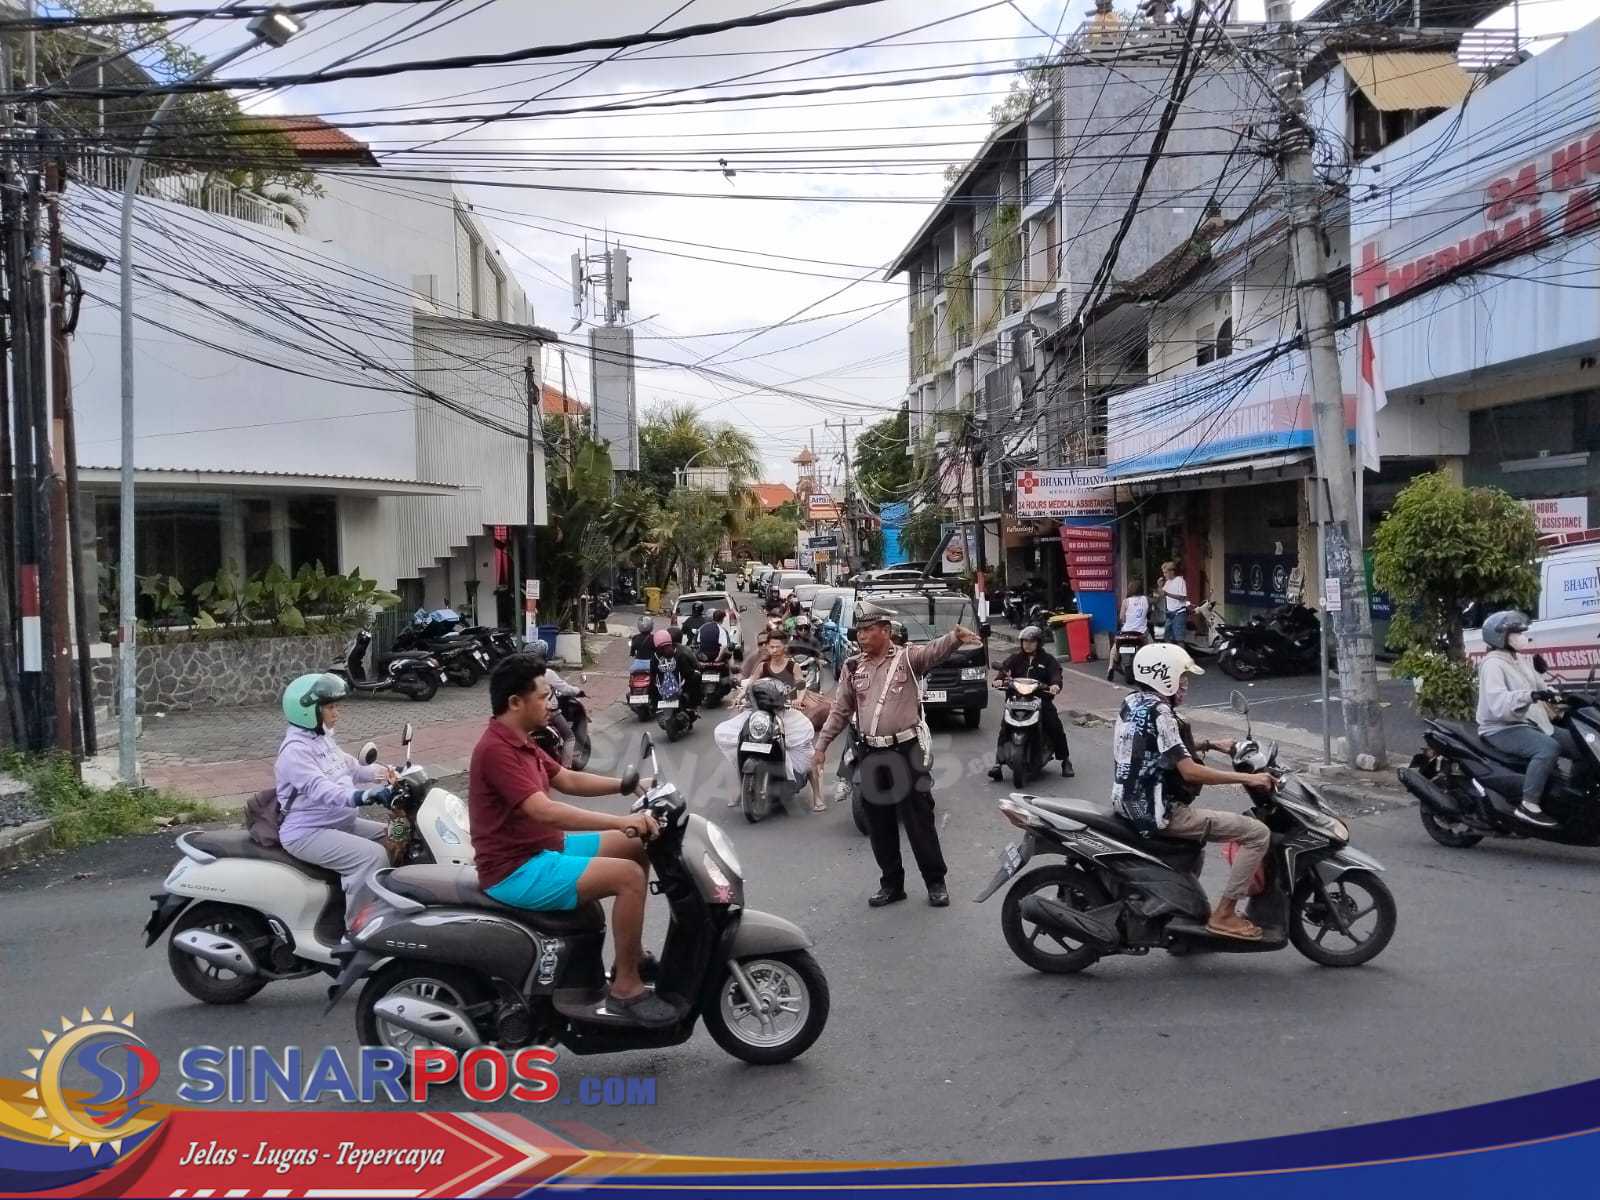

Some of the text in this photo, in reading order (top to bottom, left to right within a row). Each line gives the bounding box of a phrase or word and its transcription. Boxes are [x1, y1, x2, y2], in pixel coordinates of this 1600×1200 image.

[1487, 163, 1537, 219] 24
[1026, 500, 1047, 509] HOURS
[1048, 499, 1075, 509] MEDICAL
[1536, 502, 1558, 513] HOURS
[1542, 517, 1582, 529] ASSISTANCE
[1556, 648, 1600, 667] ASSISTA
